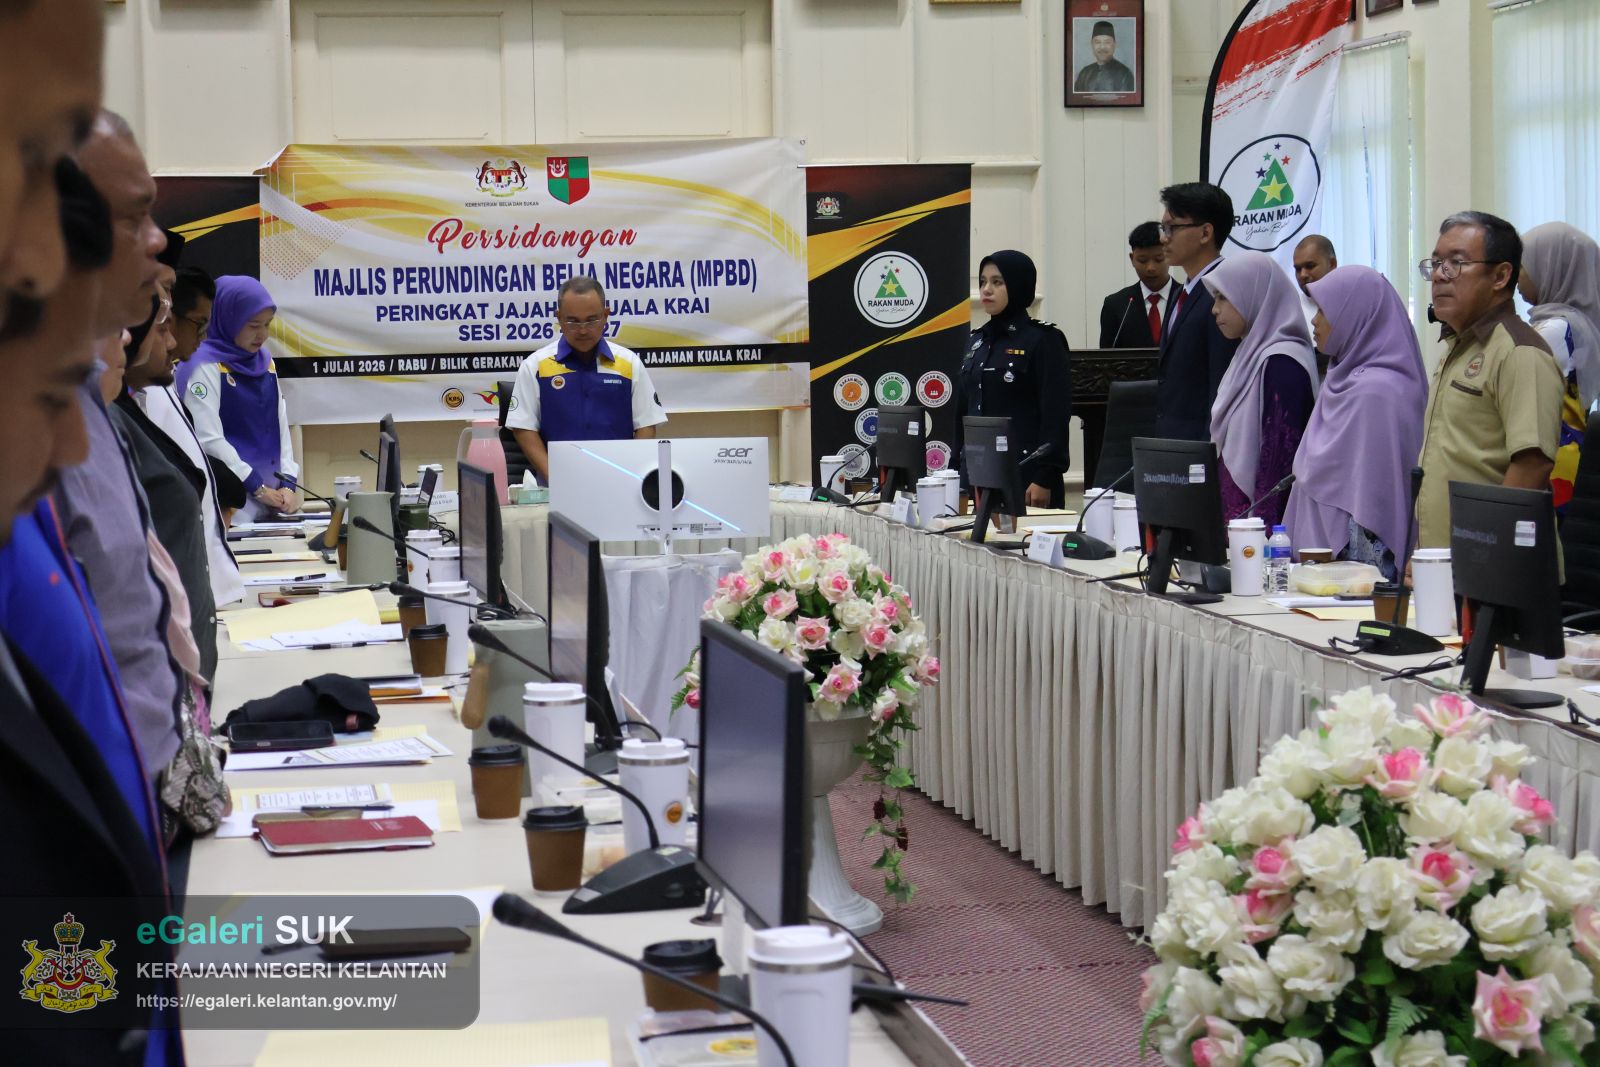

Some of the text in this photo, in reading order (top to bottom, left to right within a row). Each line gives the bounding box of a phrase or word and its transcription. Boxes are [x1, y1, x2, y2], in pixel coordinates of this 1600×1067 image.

[1233, 211, 1274, 227] RAKAN
[428, 218, 637, 258] Persidangan
[314, 268, 387, 296] MAJLIS
[393, 264, 536, 294] PERUNDINGAN
[605, 260, 685, 289] NEGARA
[691, 258, 757, 294] (MPBD)
[376, 303, 489, 322] PERINGKAT
[605, 299, 659, 316] UALA
[664, 297, 710, 315] KRAI
[458, 325, 501, 341] SESI
[506, 323, 554, 340] 2026
[313, 362, 318, 374] 1
[323, 360, 355, 373] JULAI
[358, 359, 386, 372] 2026
[398, 358, 428, 371] RABU
[440, 357, 469, 370] BILIK
[472, 355, 524, 369] GERAKAN
[644, 351, 694, 364] JAJAHAN
[697, 349, 732, 363] KUALA
[736, 348, 762, 361] KRAI
[717, 447, 753, 457] acer
